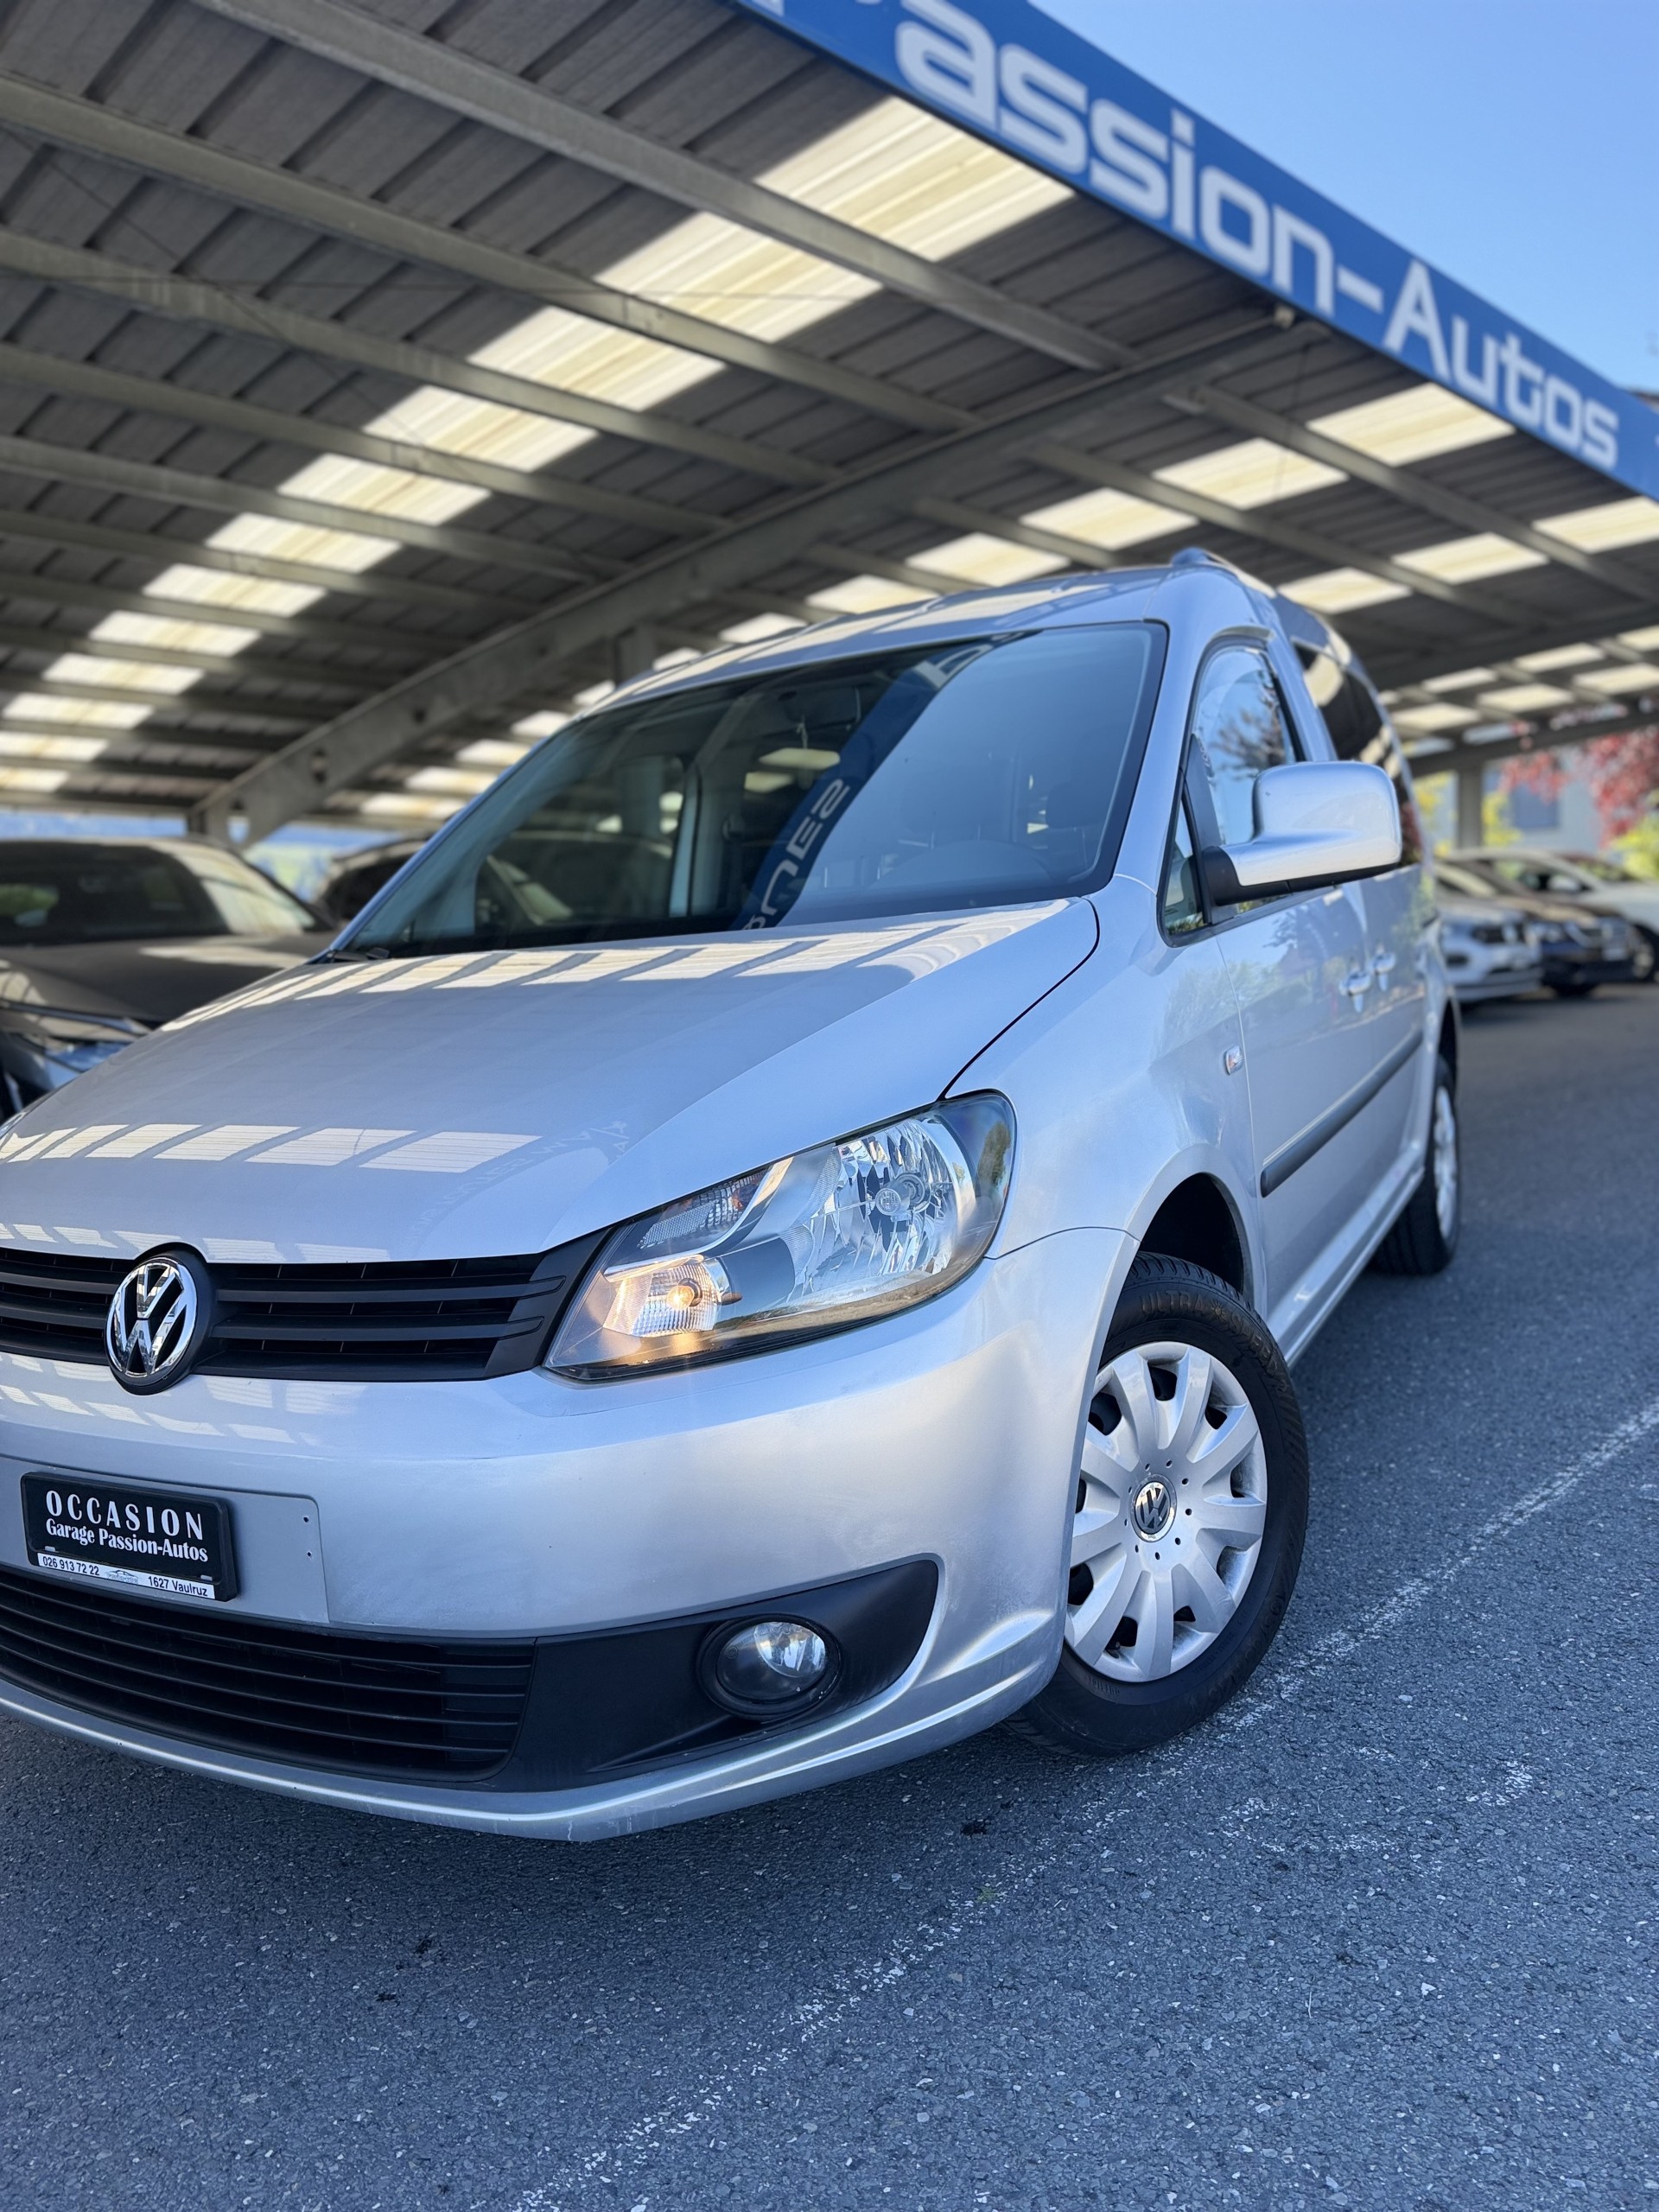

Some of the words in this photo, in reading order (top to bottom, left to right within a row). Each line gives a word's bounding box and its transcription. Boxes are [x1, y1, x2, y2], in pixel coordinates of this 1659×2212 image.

[750, 0, 1619, 471] assion-Autos
[1141, 1290, 1206, 1315] ULTRA
[46, 1490, 203, 1541] OCCASION
[46, 1518, 95, 1546] Garage
[99, 1528, 208, 1562] Passion-Autos
[42, 1556, 57, 1568] 026
[60, 1559, 75, 1572] 913
[76, 1562, 87, 1573] 72
[89, 1565, 100, 1576] 22
[148, 1576, 168, 1590] 1627
[172, 1580, 208, 1597] Vaulruz
